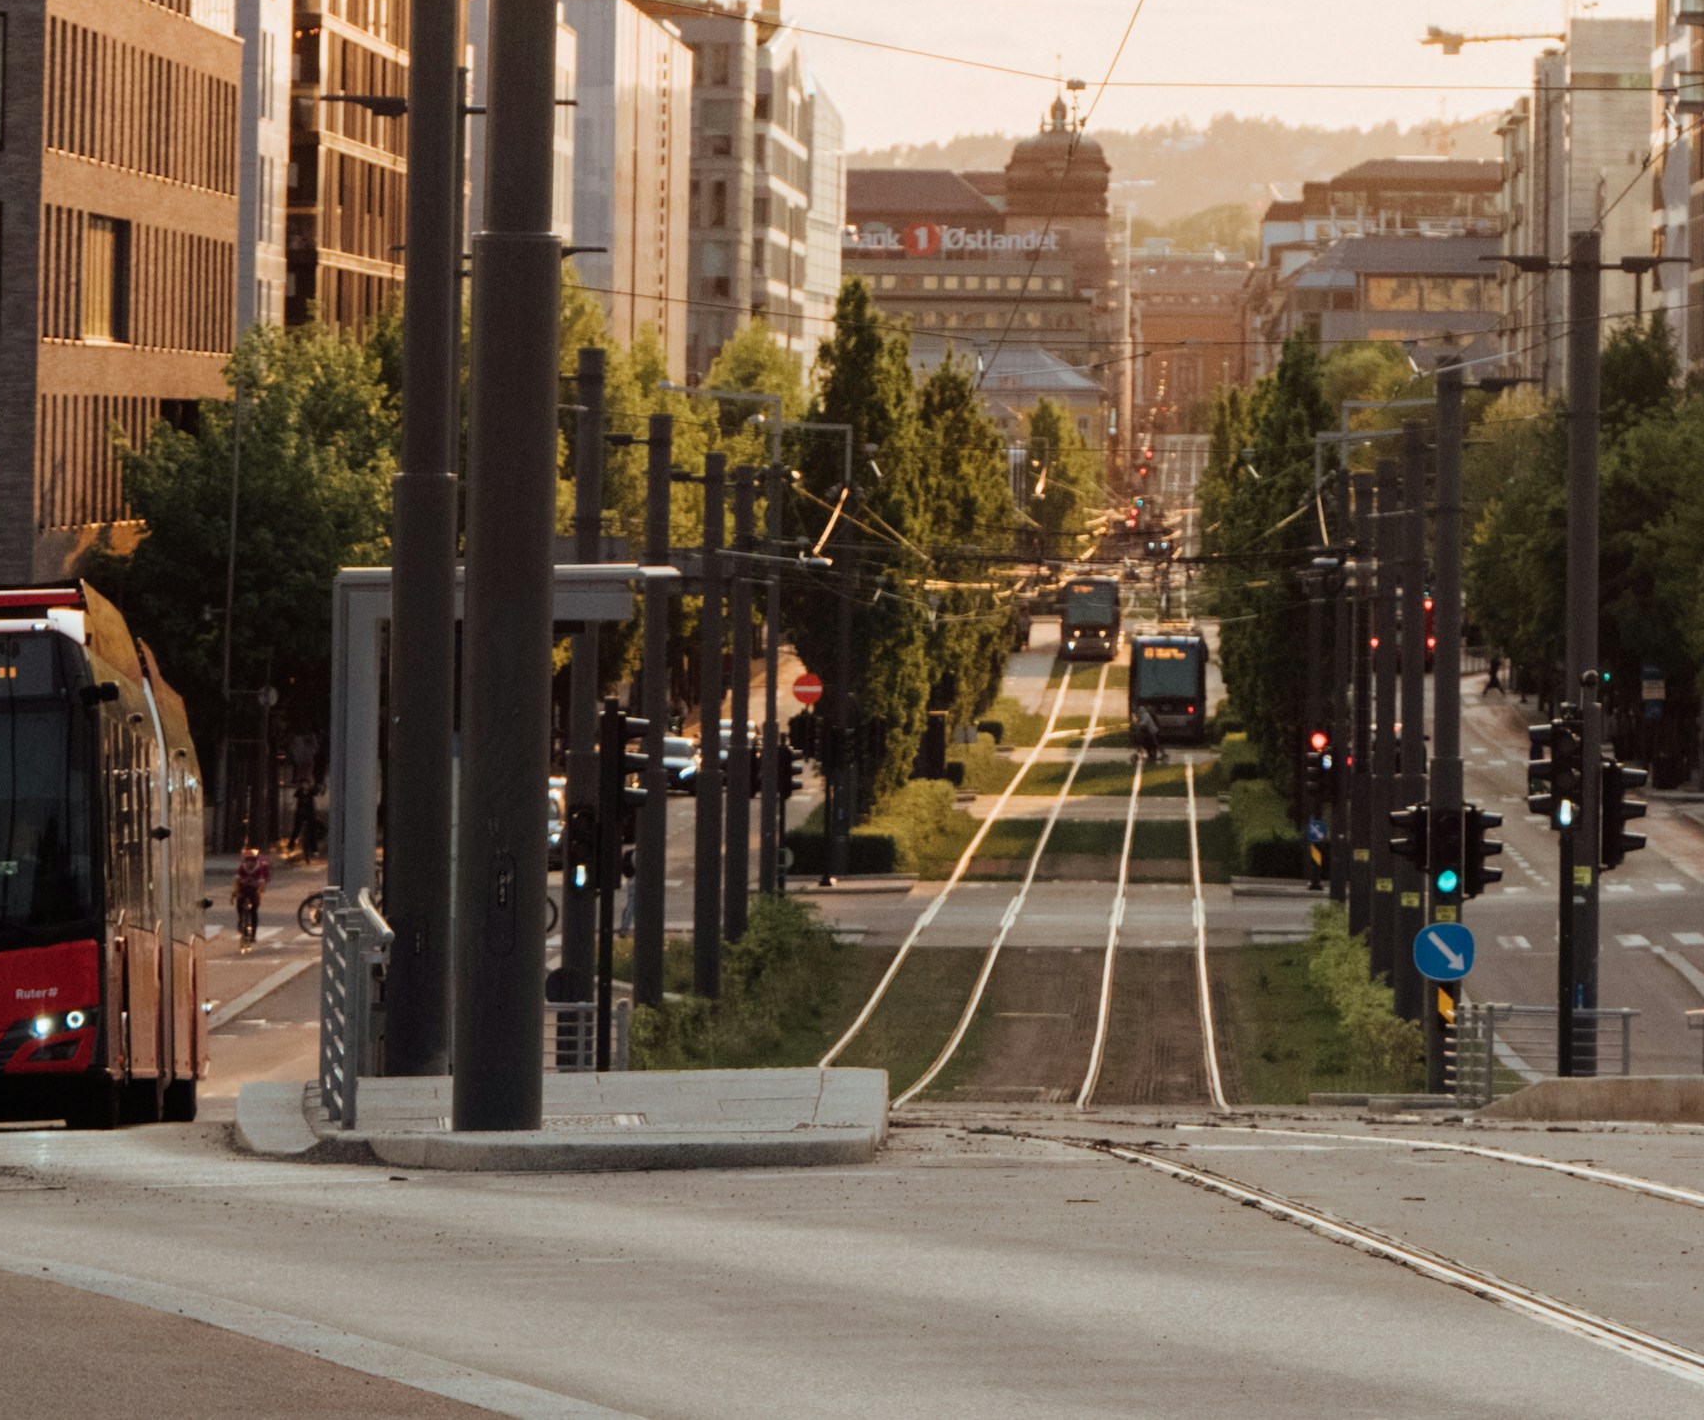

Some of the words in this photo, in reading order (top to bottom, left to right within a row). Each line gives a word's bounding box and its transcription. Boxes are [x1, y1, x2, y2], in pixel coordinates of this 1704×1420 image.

[914, 227, 928, 250] 1
[946, 226, 1058, 250] Østlandet
[15, 987, 58, 1000] Ruter#
